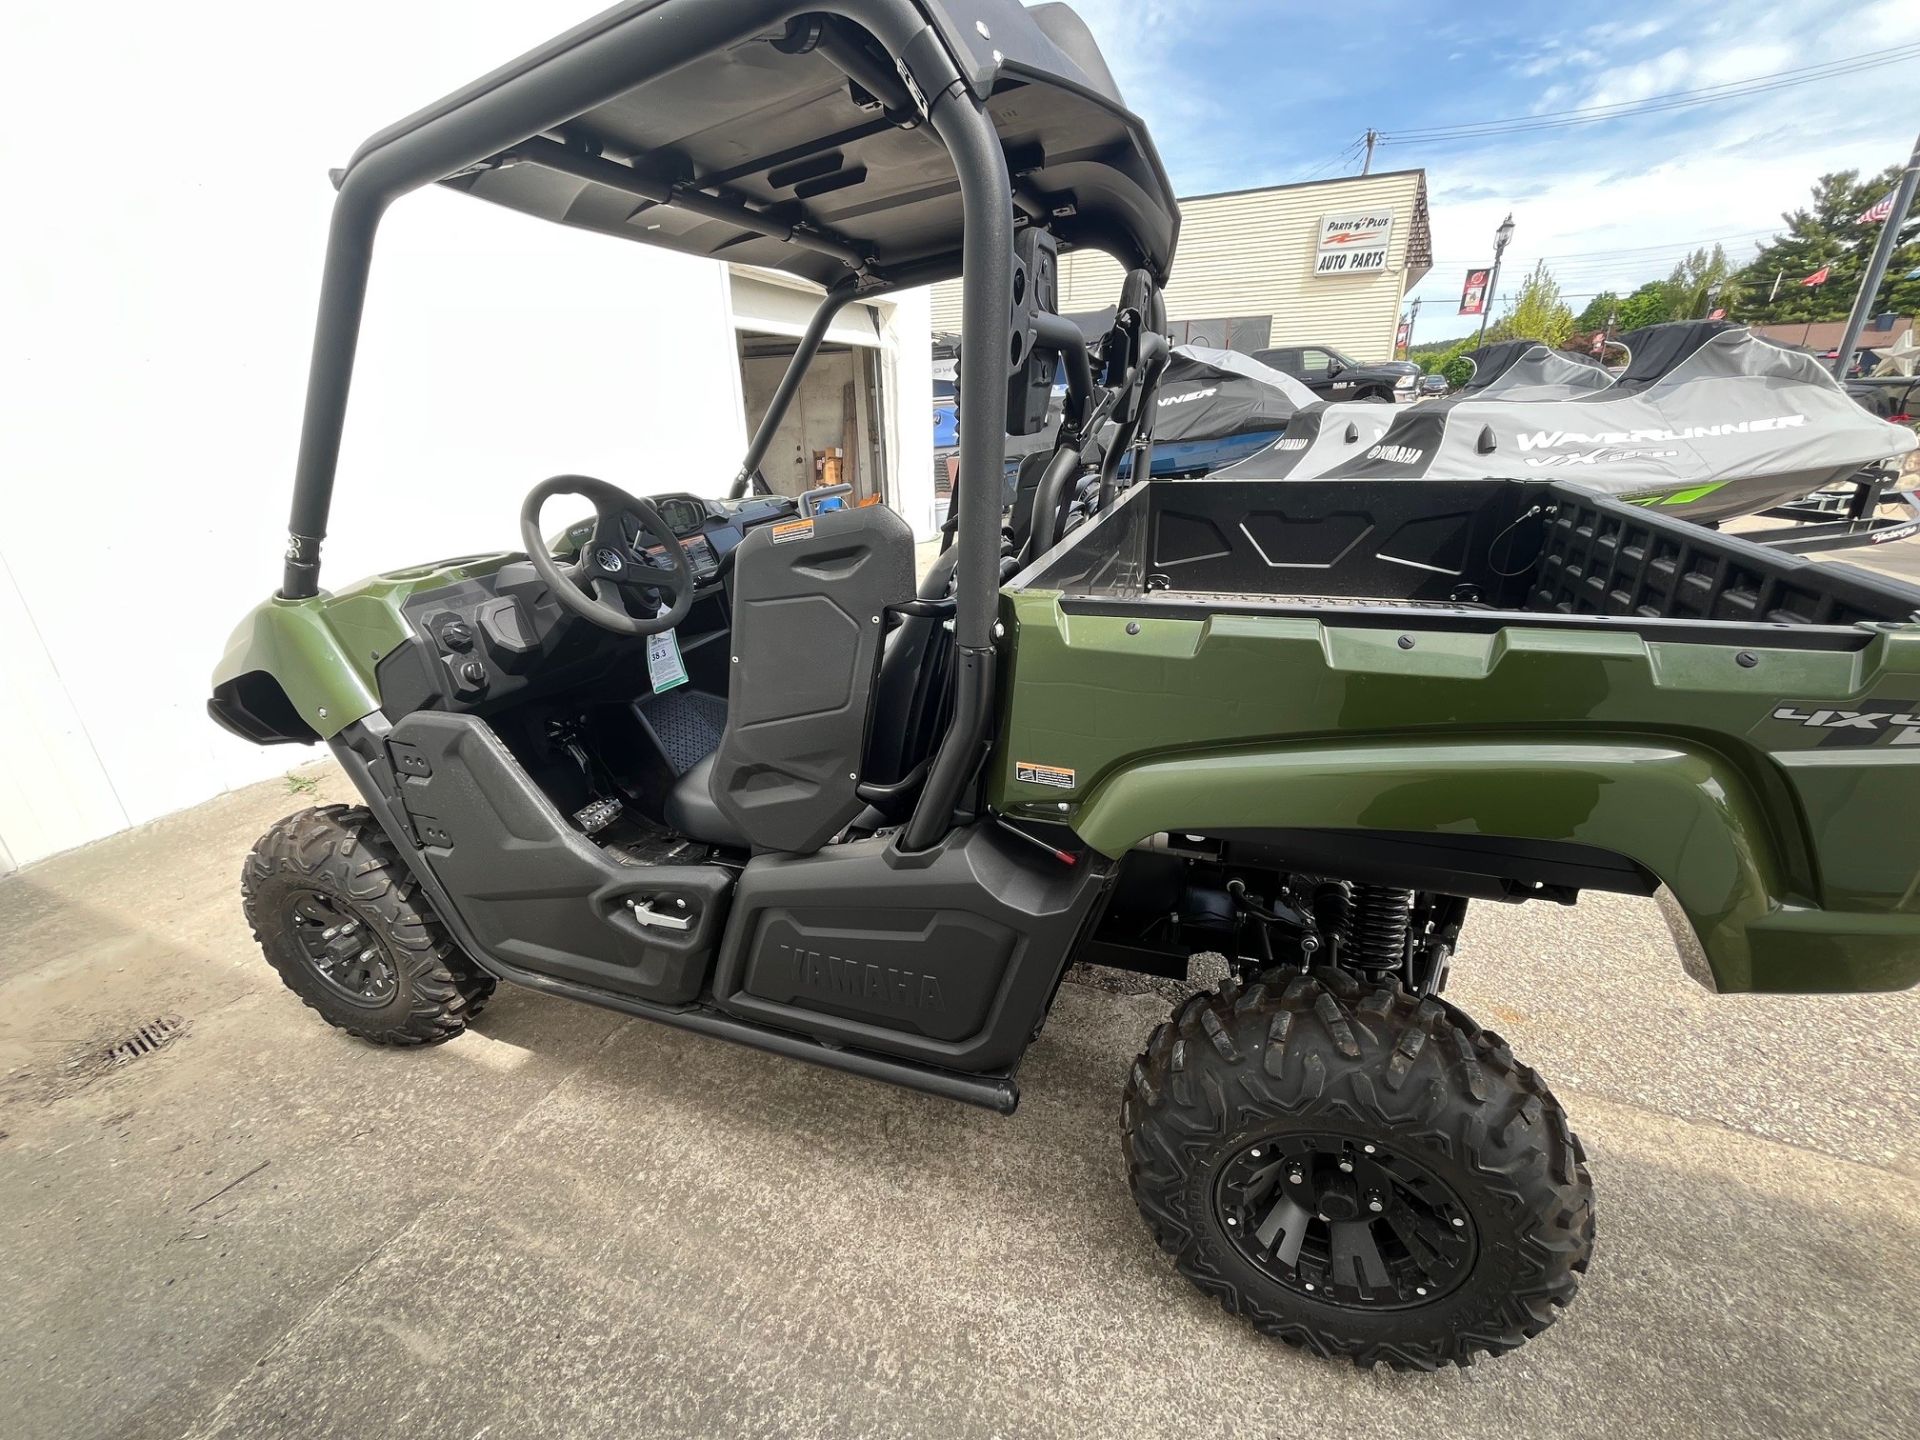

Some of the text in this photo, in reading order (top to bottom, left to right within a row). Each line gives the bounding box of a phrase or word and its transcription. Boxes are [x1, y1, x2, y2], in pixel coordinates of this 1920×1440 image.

[1366, 218, 1389, 228] PLUS
[1318, 251, 1384, 271] AUTO PARTS
[1157, 388, 1217, 407] NNER
[1516, 414, 1804, 451] WAVERUNNER
[1377, 445, 1423, 464] YAMAHA
